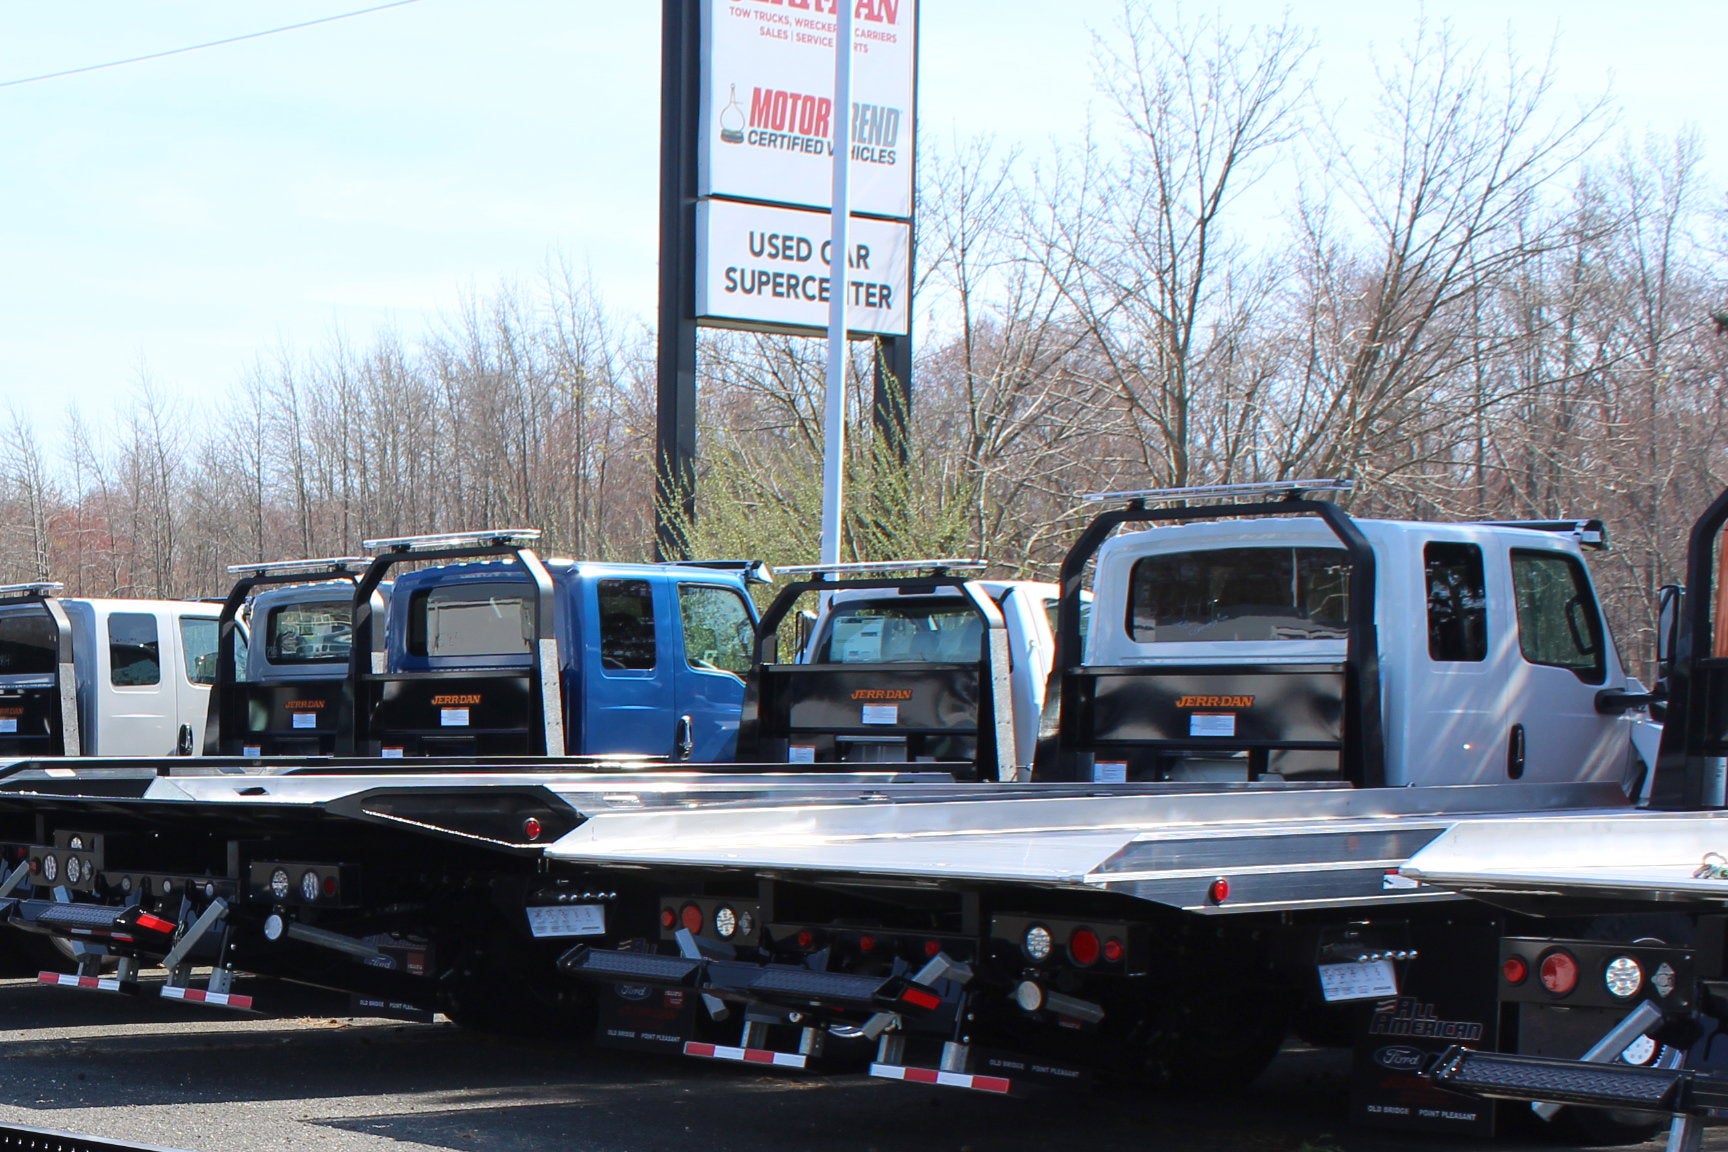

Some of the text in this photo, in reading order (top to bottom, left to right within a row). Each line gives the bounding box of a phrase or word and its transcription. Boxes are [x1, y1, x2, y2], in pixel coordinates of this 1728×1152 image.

[728, 6, 752, 18] TOW
[753, 10, 792, 27] TRUCKS,
[854, 27, 897, 44] CARRIERS
[759, 26, 789, 40] SALES
[795, 32, 834, 48] SERVICE
[748, 86, 900, 148] MOTOR REND
[747, 129, 825, 155] CERTIFIED
[748, 231, 871, 270] USED CR
[724, 266, 893, 310] SUPERCETER
[1393, 997, 1438, 1020] ALL
[1368, 1012, 1484, 1041] AMERICAN
[1382, 1048, 1421, 1066] Ford
[1367, 1104, 1477, 1121] OLD BRIDGE POINT PLEASANT
